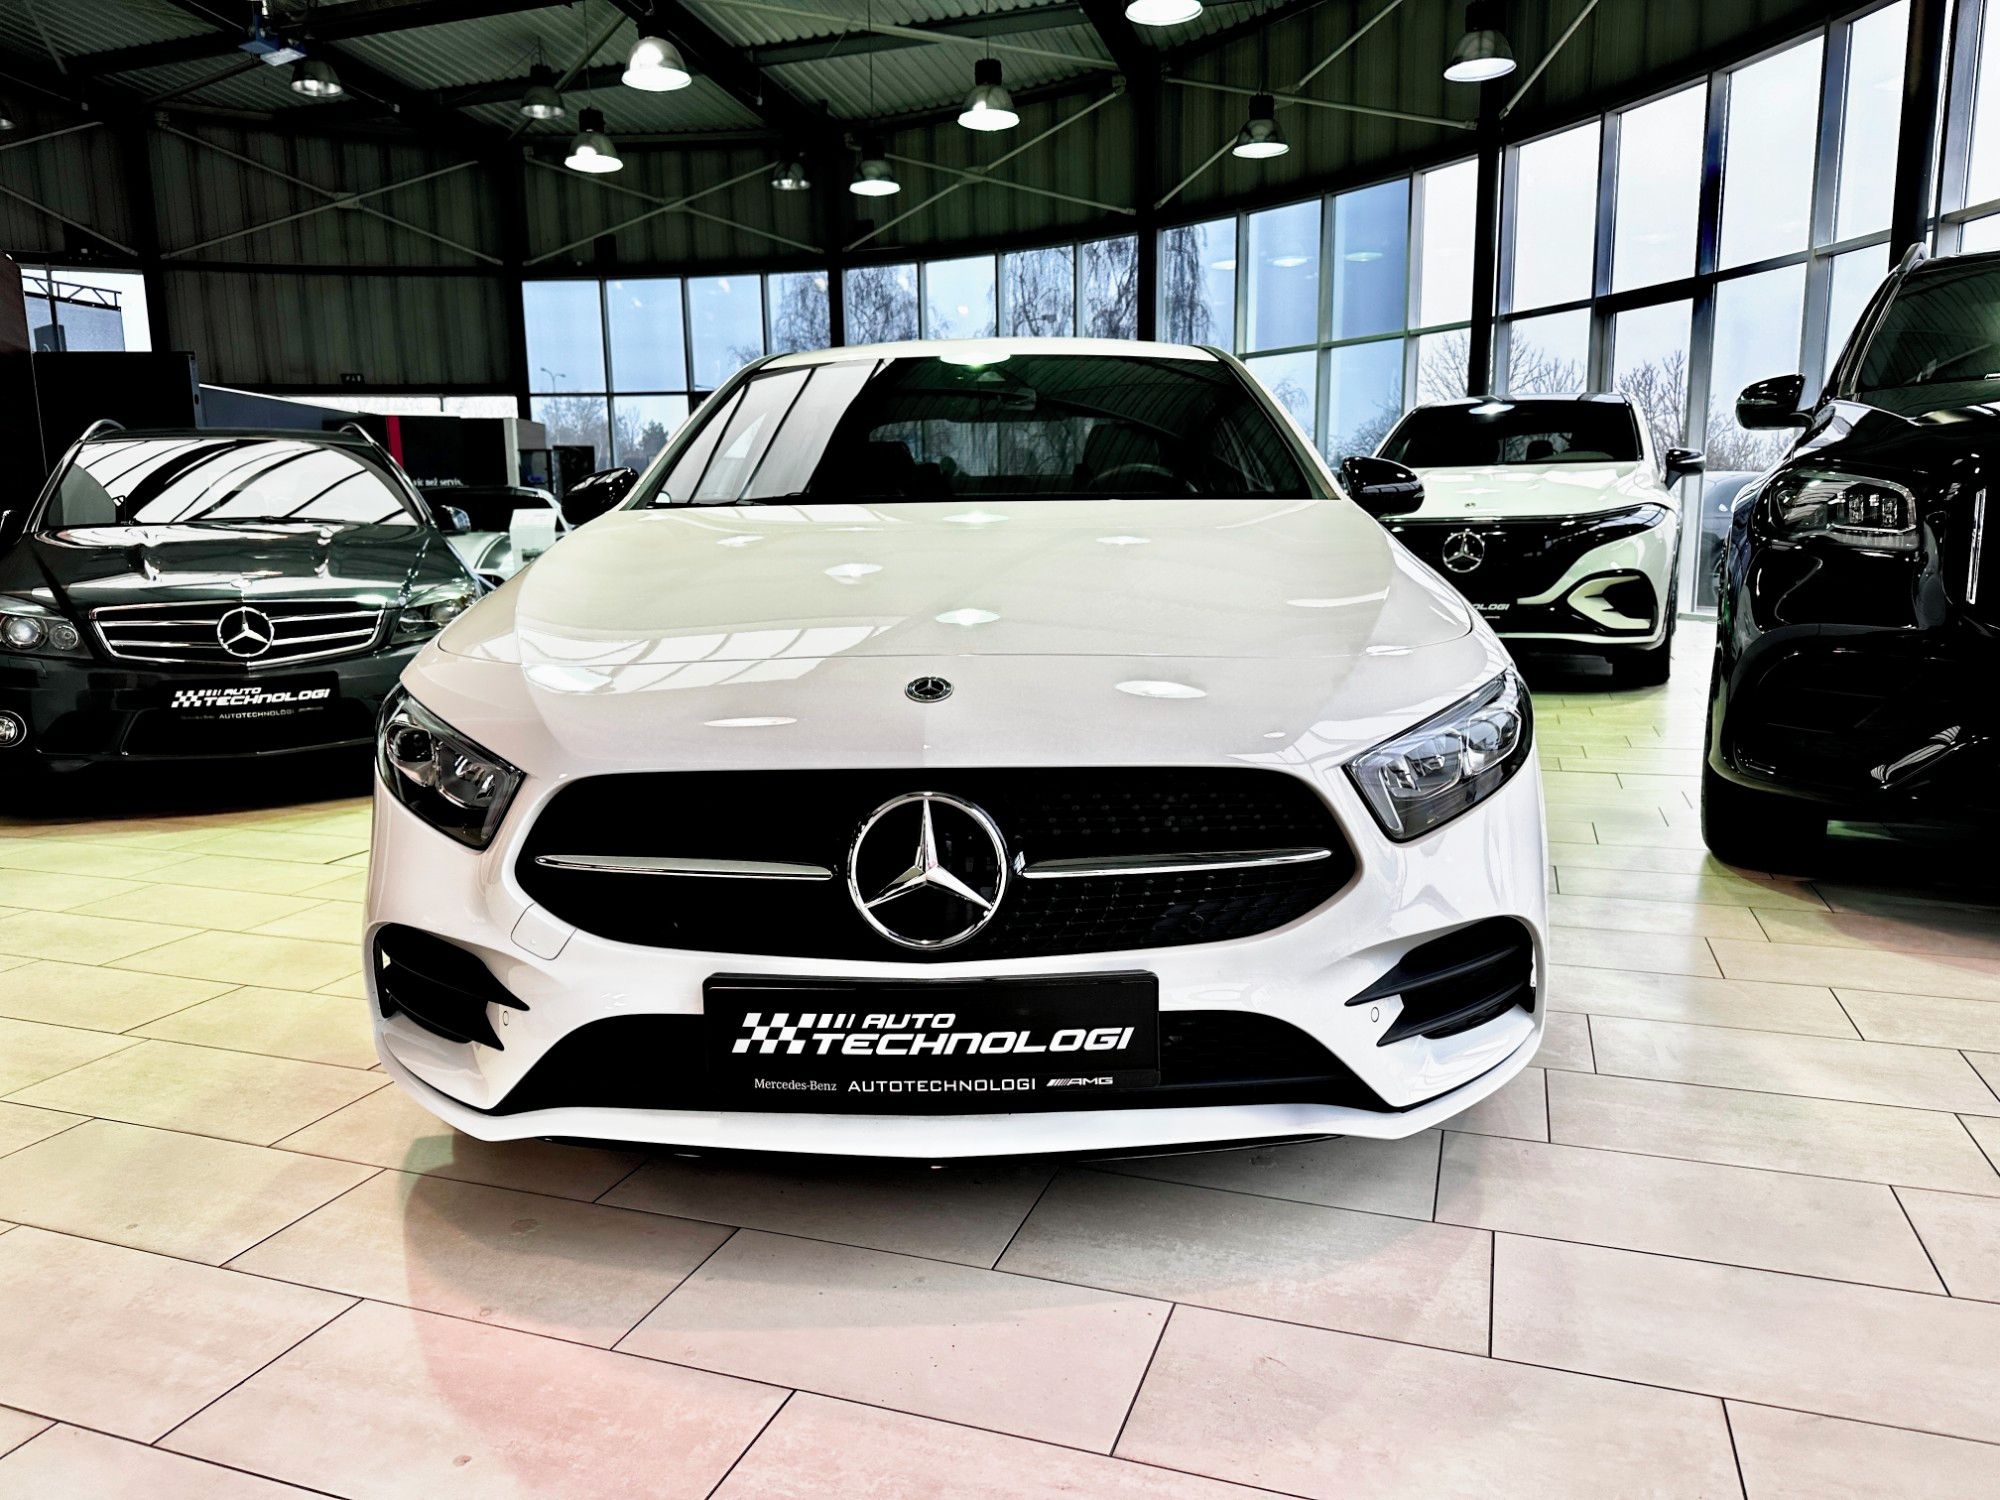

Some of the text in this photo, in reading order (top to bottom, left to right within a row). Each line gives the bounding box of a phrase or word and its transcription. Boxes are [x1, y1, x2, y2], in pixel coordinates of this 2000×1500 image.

[204, 688, 331, 706] TECHNOLOGI
[224, 687, 262, 695] AUTO
[219, 709, 294, 719] AUTOTECHNOLOGI
[862, 1013, 956, 1029] AUTO
[812, 1027, 1134, 1055] TECHNOLOGI
[755, 1077, 1113, 1092] Mercedes-Benz AUTOTECHNOLOGI AMG
